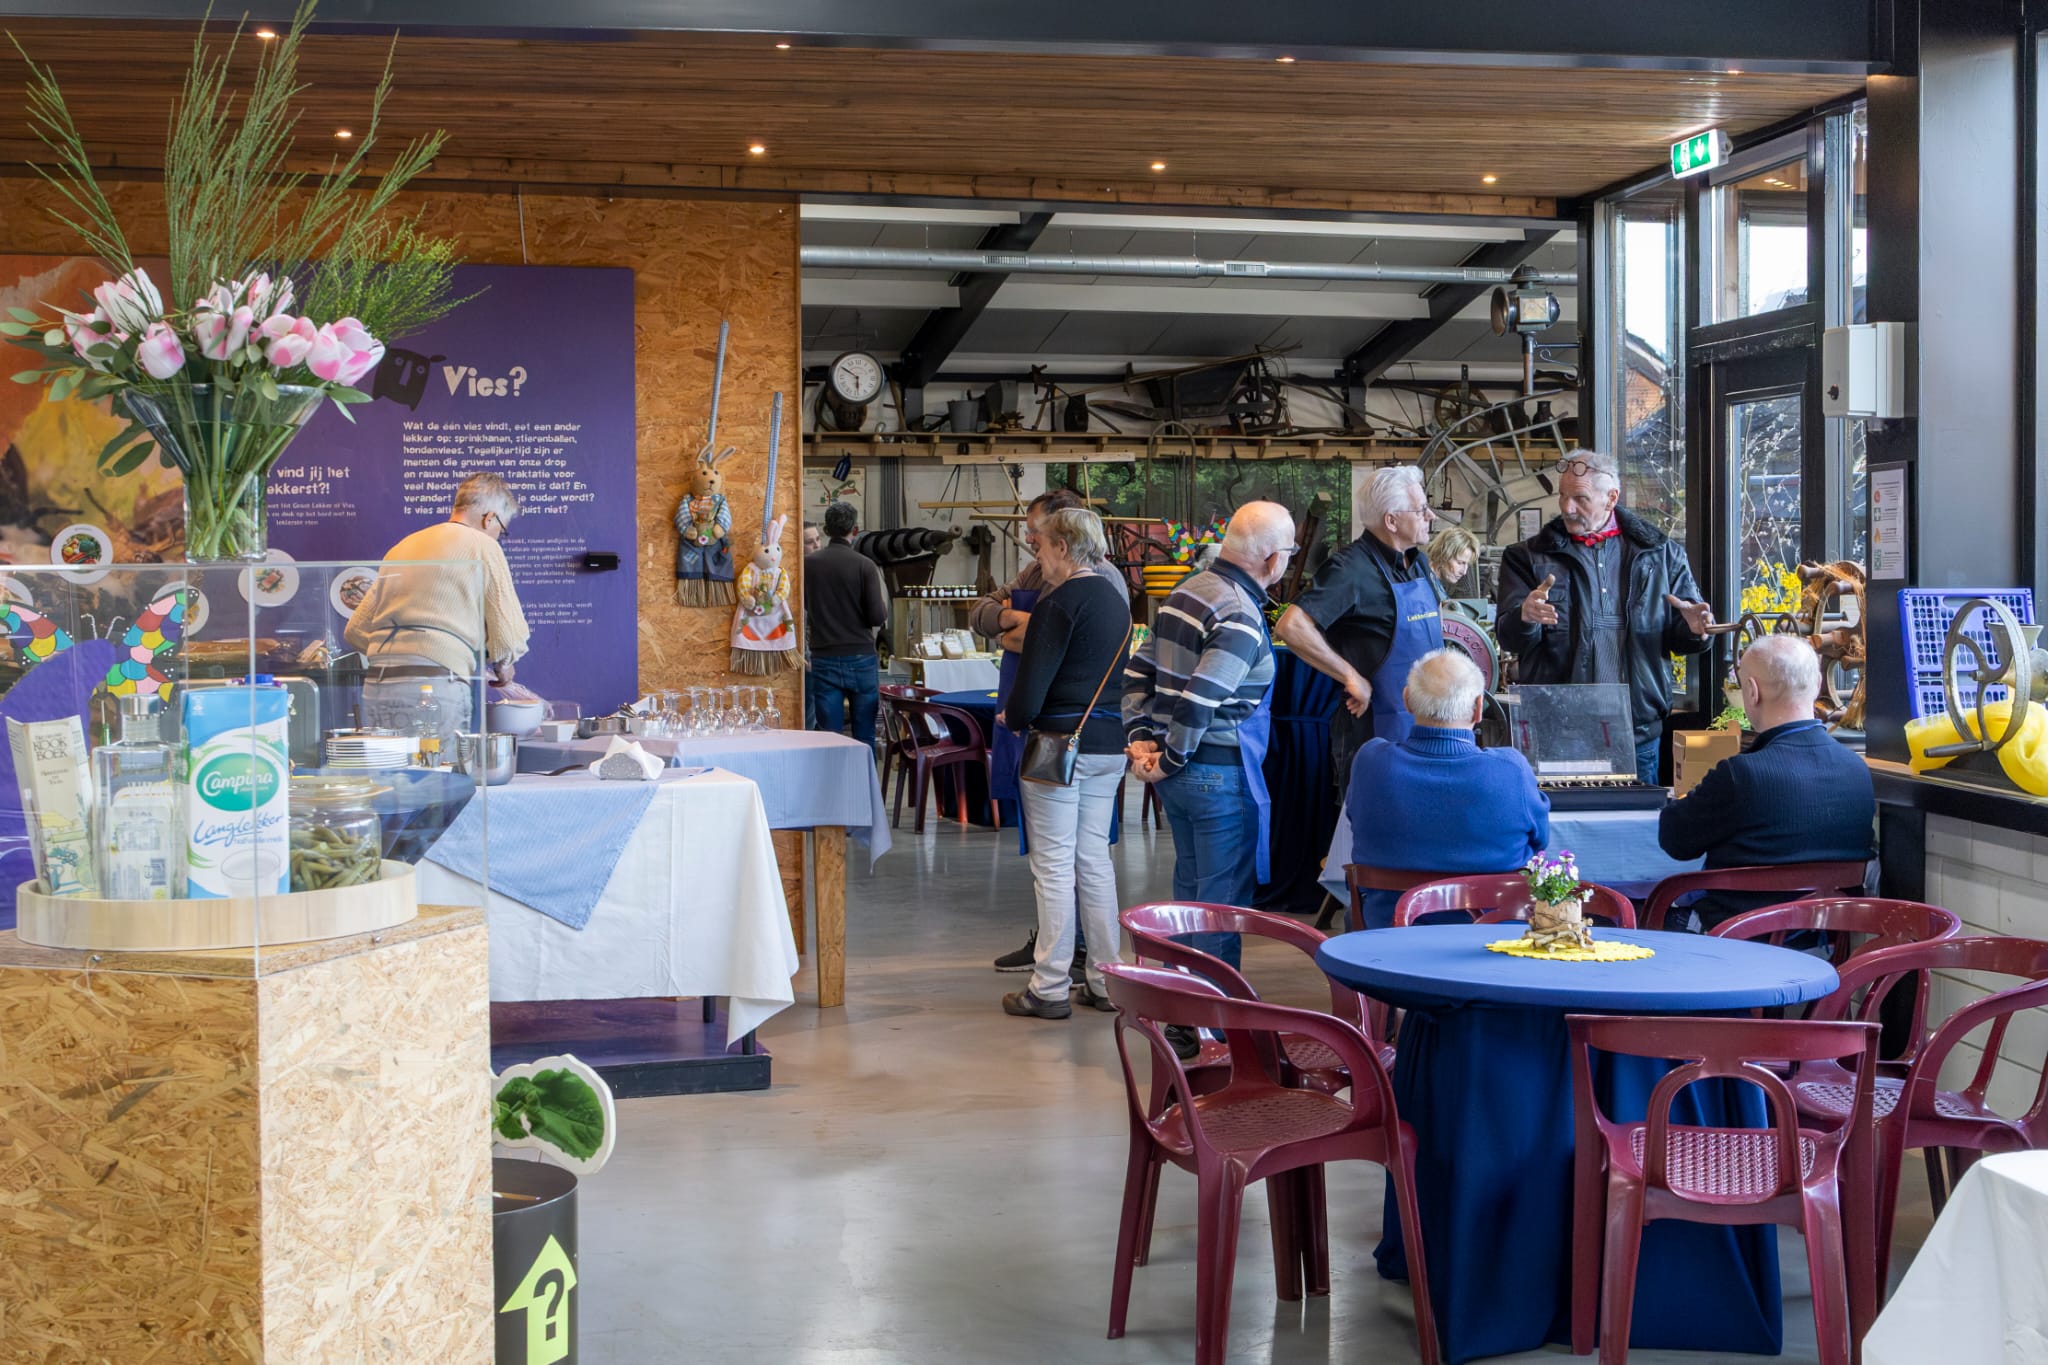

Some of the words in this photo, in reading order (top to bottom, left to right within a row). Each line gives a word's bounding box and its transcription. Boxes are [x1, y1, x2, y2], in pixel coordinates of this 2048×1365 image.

[442, 366, 528, 396] Vies?
[403, 422, 423, 431] Wat
[428, 422, 439, 431] de
[464, 422, 482, 431] vies
[486, 422, 512, 432] vindt,
[514, 422, 530, 431] eet
[554, 422, 581, 431] ander
[403, 434, 433, 442] lekker
[436, 435, 452, 444] op:
[454, 434, 512, 444] sprinkhanen,
[516, 434, 578, 444] stierenballen,
[403, 446, 464, 455] hondenvlees.
[468, 446, 531, 456] Tegelijkertijd
[534, 446, 550, 456] zijn
[443, 458, 458, 466] die
[461, 460, 496, 468] gruwen
[544, 458, 566, 468] drop
[277, 466, 304, 478] vind
[309, 466, 322, 481] jij
[328, 466, 350, 478] het
[404, 470, 416, 478] en
[418, 470, 449, 478] rauwe
[508, 470, 550, 478] traktatie
[554, 470, 575, 478] voor
[267, 482, 330, 494] ekkerst?!
[404, 482, 424, 490] veel
[427, 482, 458, 490] Nederl
[538, 482, 546, 490] is
[550, 482, 570, 490] dat?
[574, 482, 586, 490] En
[404, 494, 452, 502] verandert
[518, 494, 526, 503] je
[530, 494, 557, 502] ouder
[560, 494, 595, 502] wordt?
[404, 506, 412, 514] Is
[415, 506, 433, 514] vies
[522, 506, 541, 515] juist
[545, 506, 568, 514] niet?
[202, 768, 273, 796] Campina
